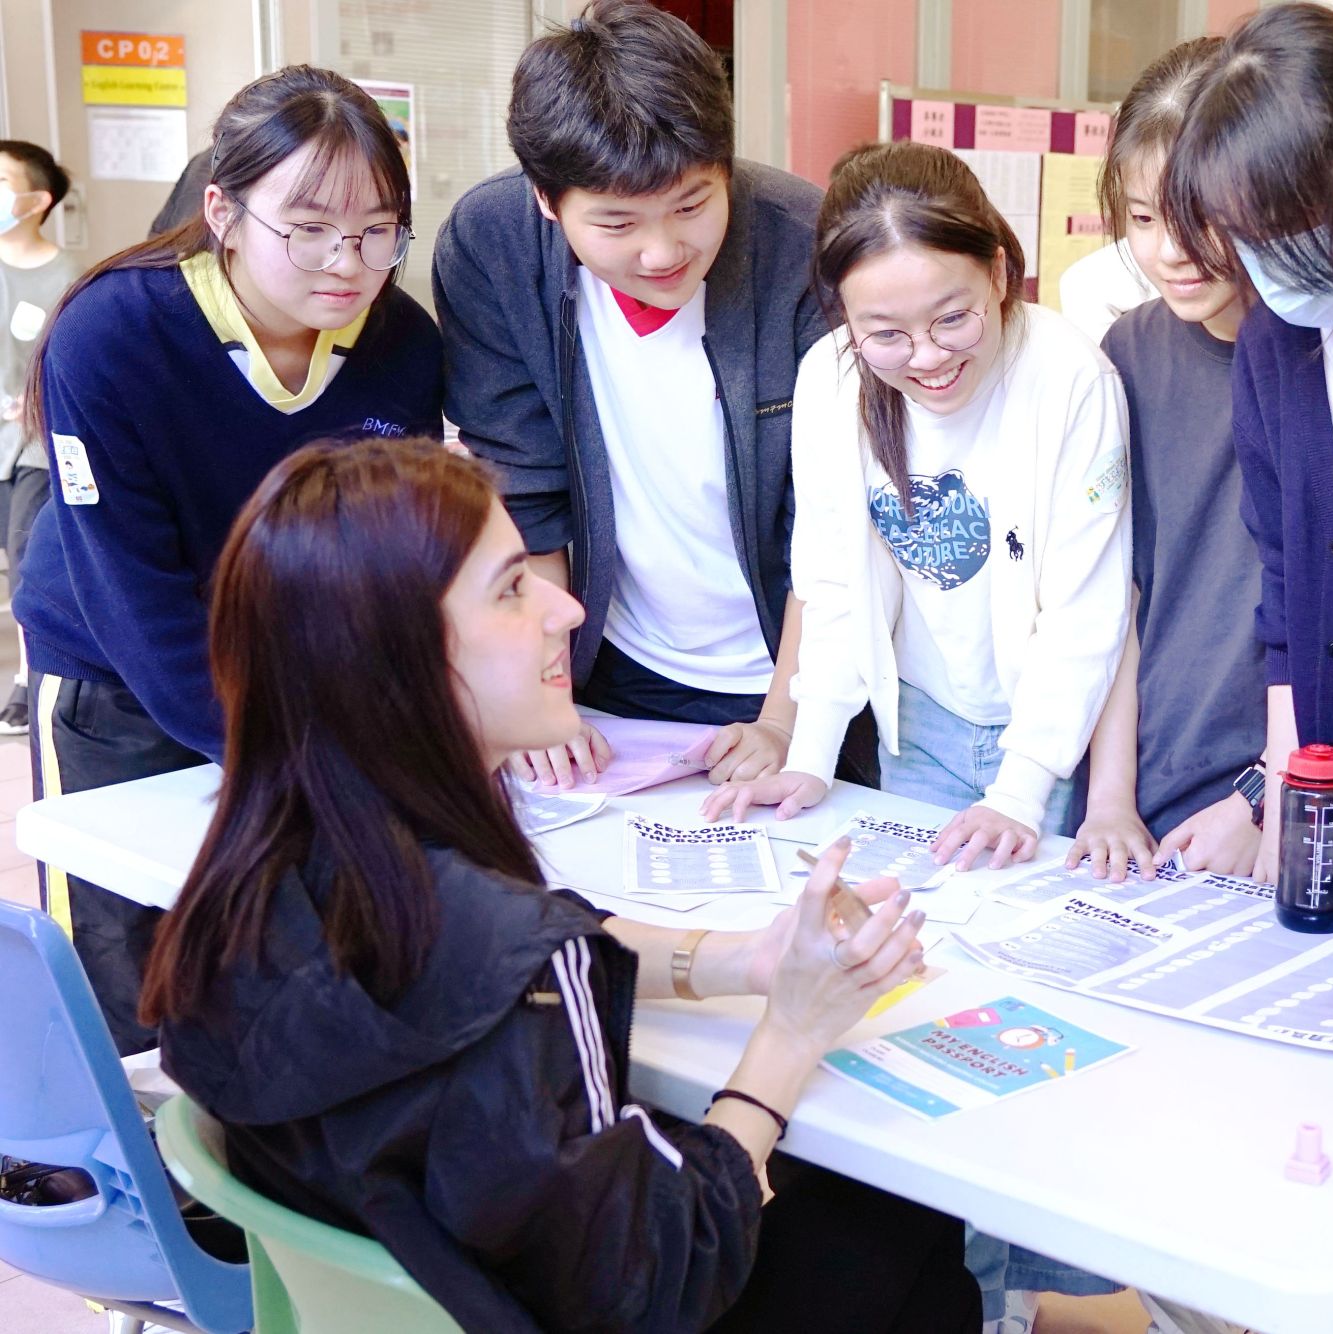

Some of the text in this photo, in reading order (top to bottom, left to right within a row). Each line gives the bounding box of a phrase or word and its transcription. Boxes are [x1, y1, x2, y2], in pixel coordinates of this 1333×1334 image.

[97, 39, 169, 60] CP02
[893, 540, 970, 567] FUTURE
[633, 822, 757, 839] STAMPS FROM
[639, 831, 671, 843] THE
[653, 823, 736, 834] GET YOUR
[883, 821, 938, 835] GET YO
[921, 1036, 1008, 1079] PASSPORT
[930, 1029, 1029, 1077] MY ENGLISH
